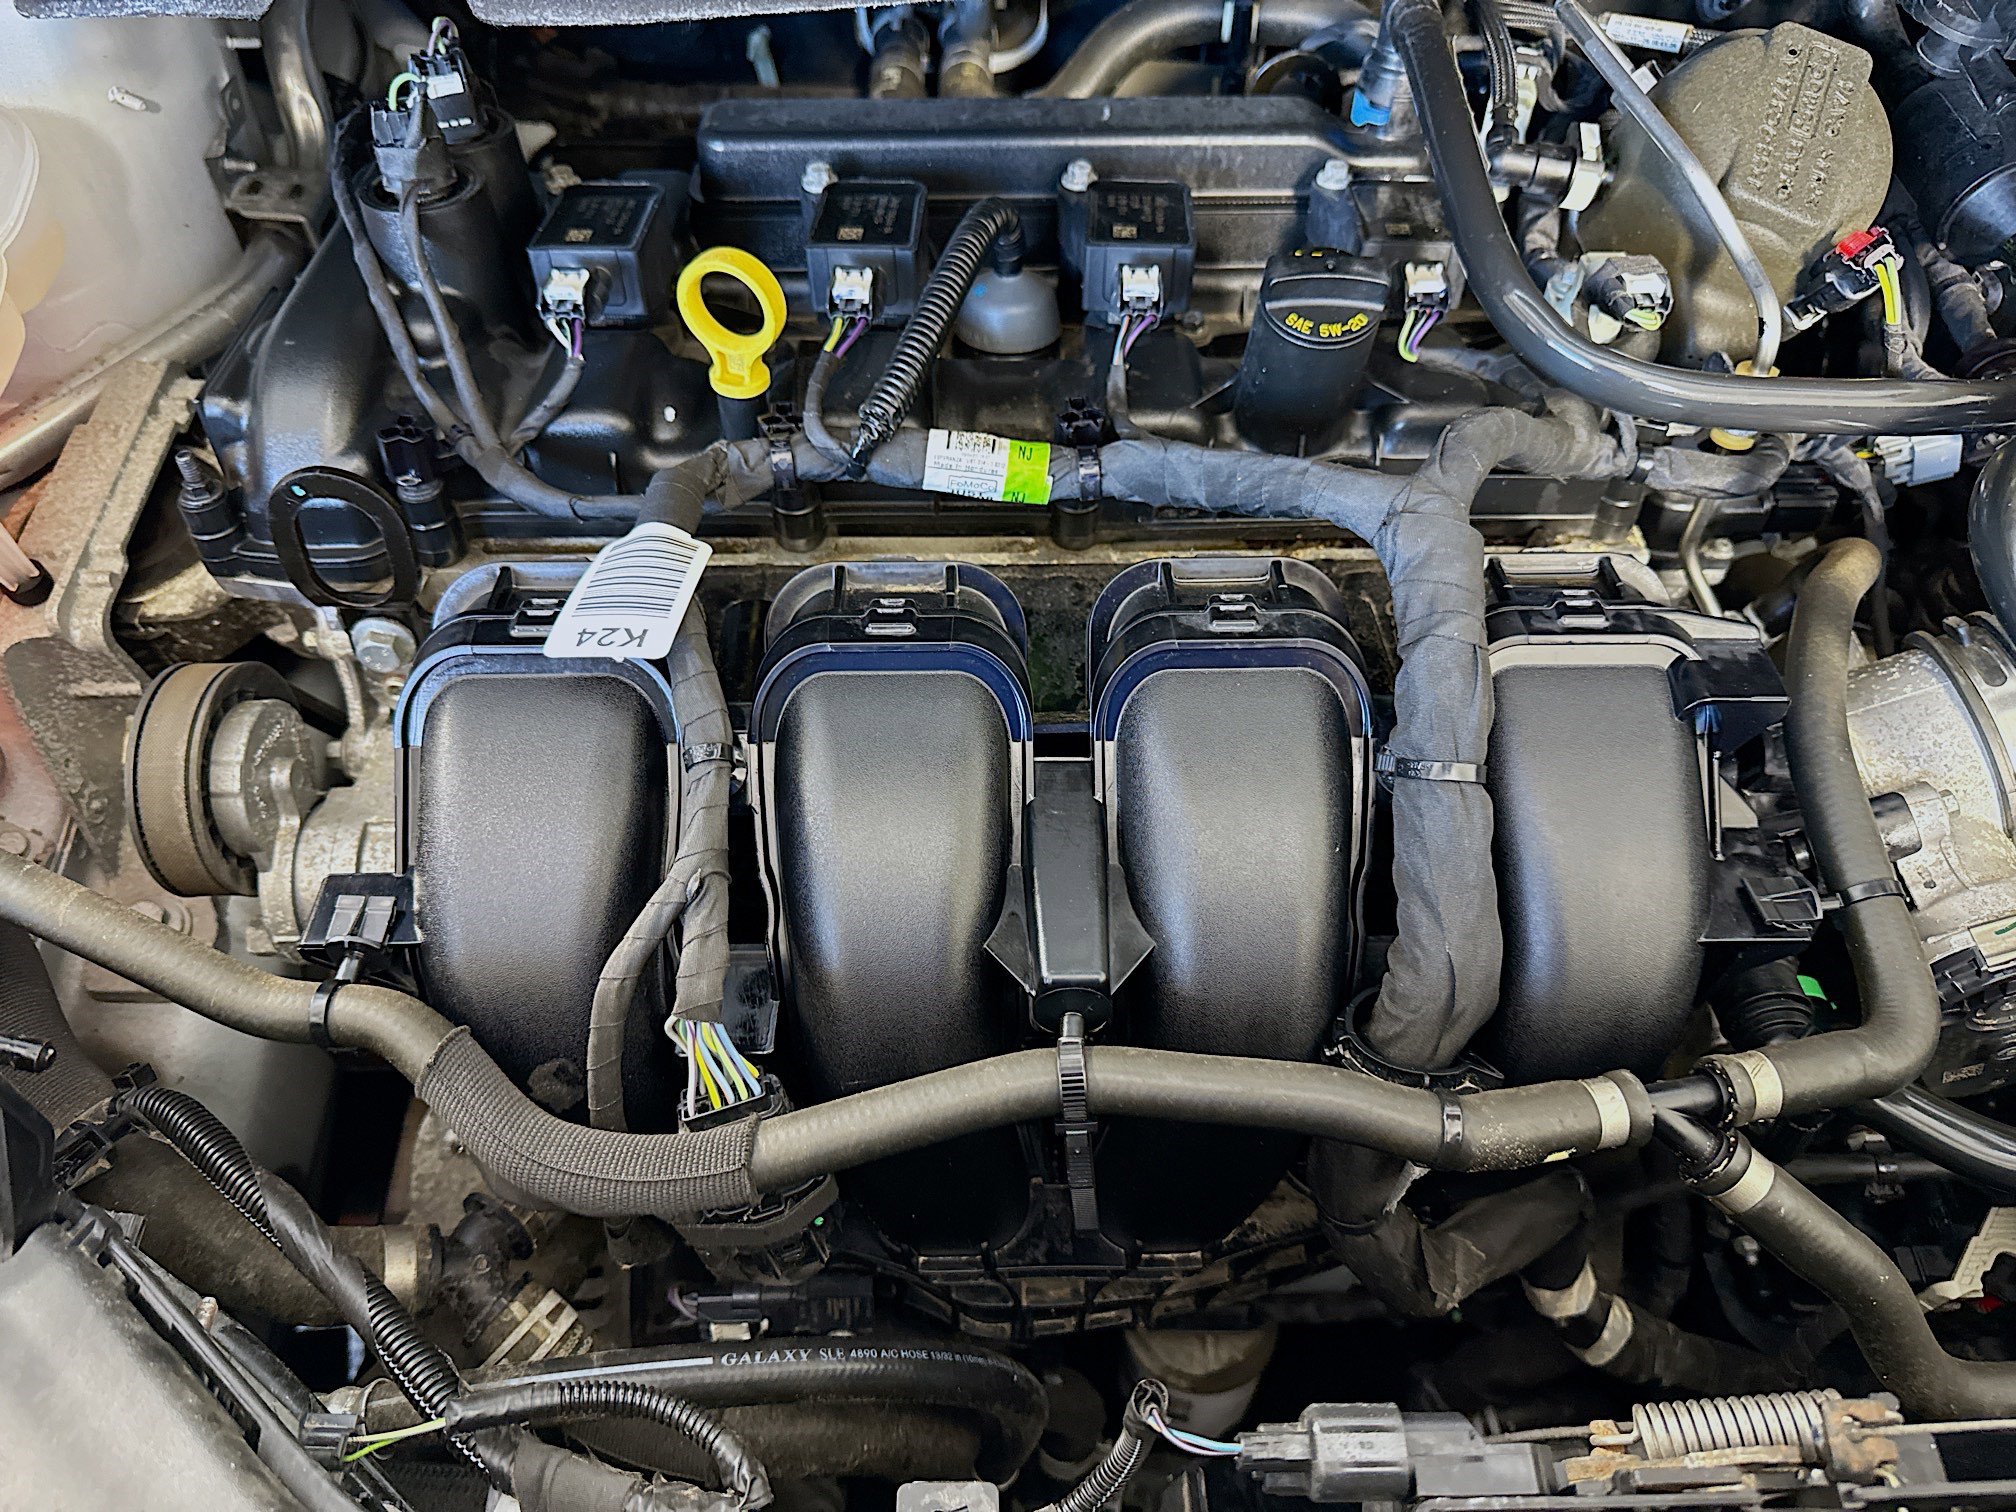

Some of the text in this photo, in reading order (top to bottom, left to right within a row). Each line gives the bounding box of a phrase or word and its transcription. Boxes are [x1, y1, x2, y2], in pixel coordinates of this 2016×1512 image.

[1285, 312, 1369, 338] SAE 5W-20
[1018, 445, 1033, 461] NJ
[950, 480, 996, 491] FoMoCo
[1010, 491, 1026, 503] NJ
[576, 628, 649, 648] K24
[721, 1349, 812, 1366] GALAXY
[850, 1348, 877, 1359] 4890
[881, 1348, 899, 1359] A/C
[901, 1349, 929, 1360] HOSE
